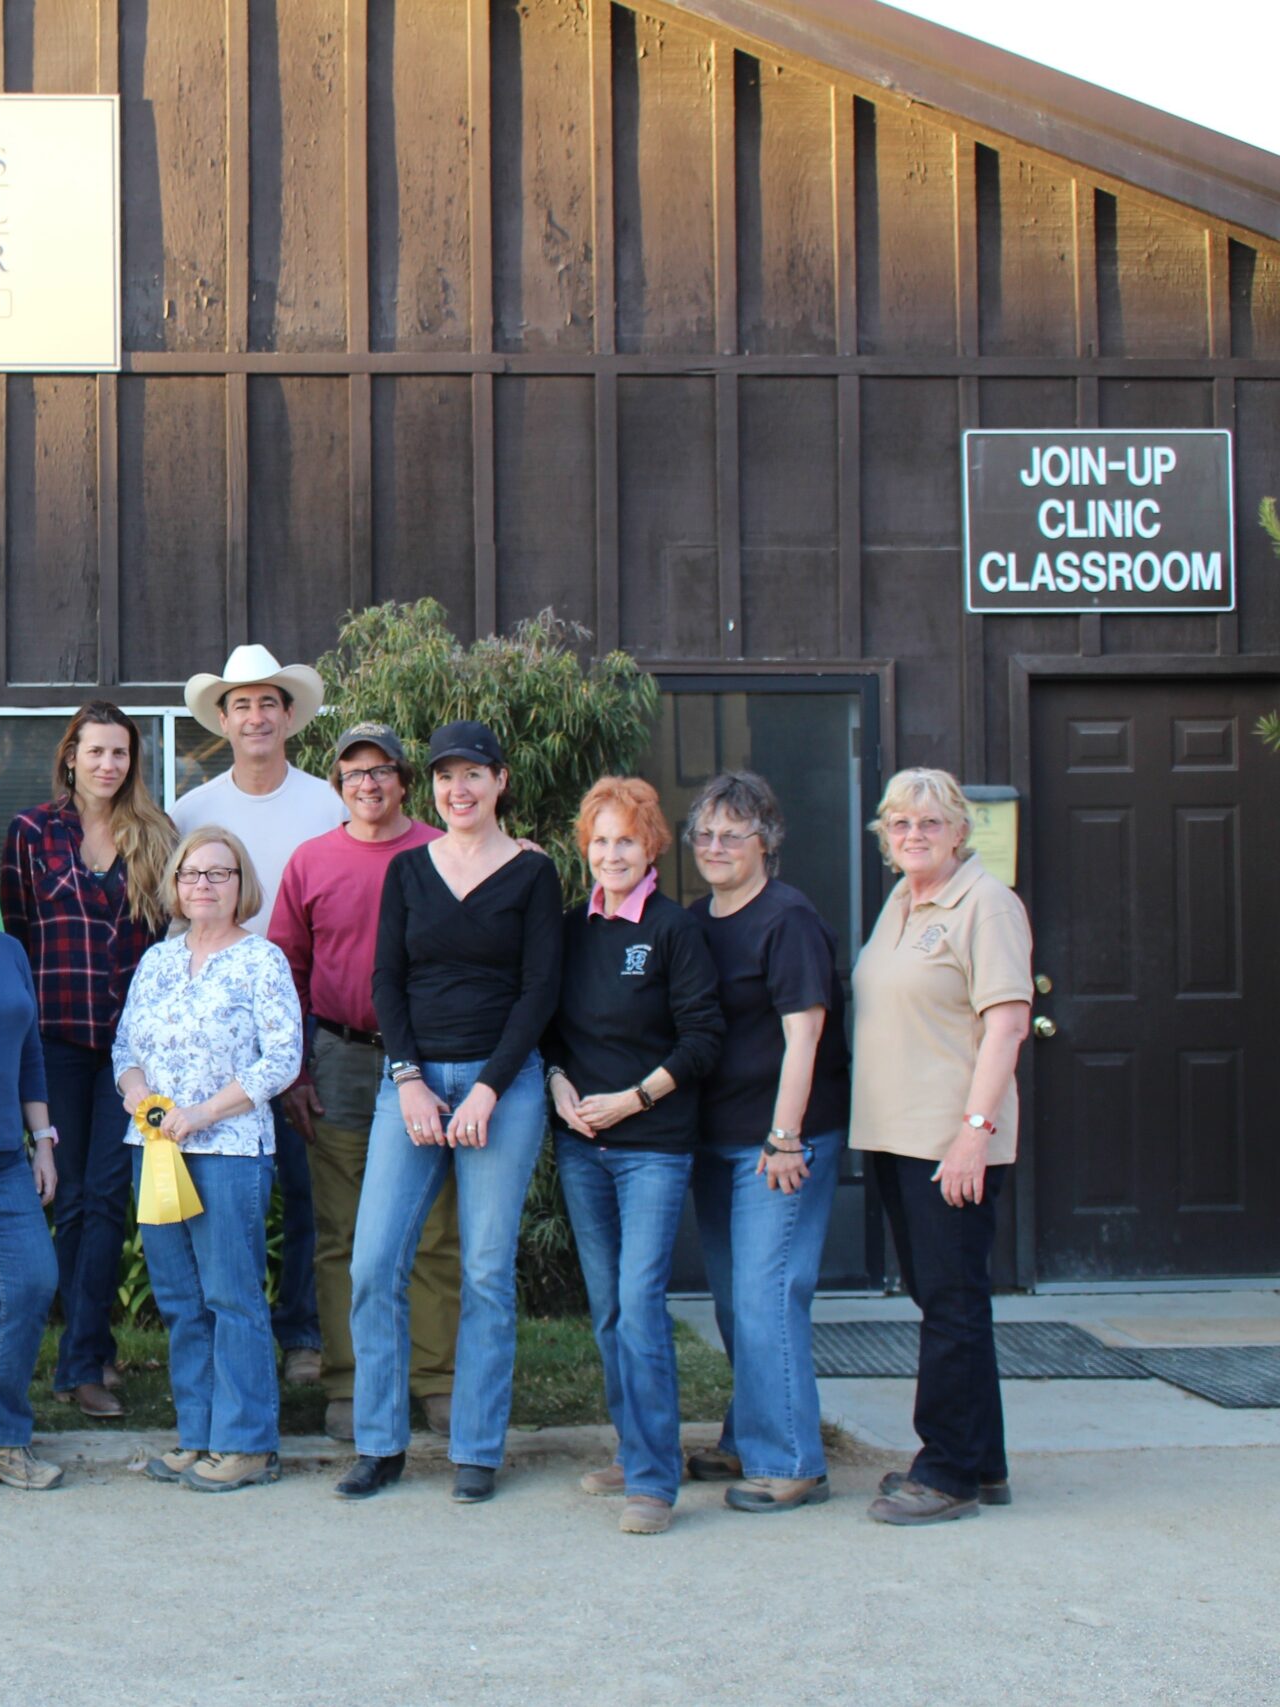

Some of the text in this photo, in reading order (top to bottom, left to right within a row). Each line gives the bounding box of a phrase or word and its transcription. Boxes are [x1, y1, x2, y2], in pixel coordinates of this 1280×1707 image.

[1020, 445, 1177, 487] JOIN-UP
[1037, 498, 1162, 540] CLINIC
[979, 550, 1223, 593] CLASSROOM
